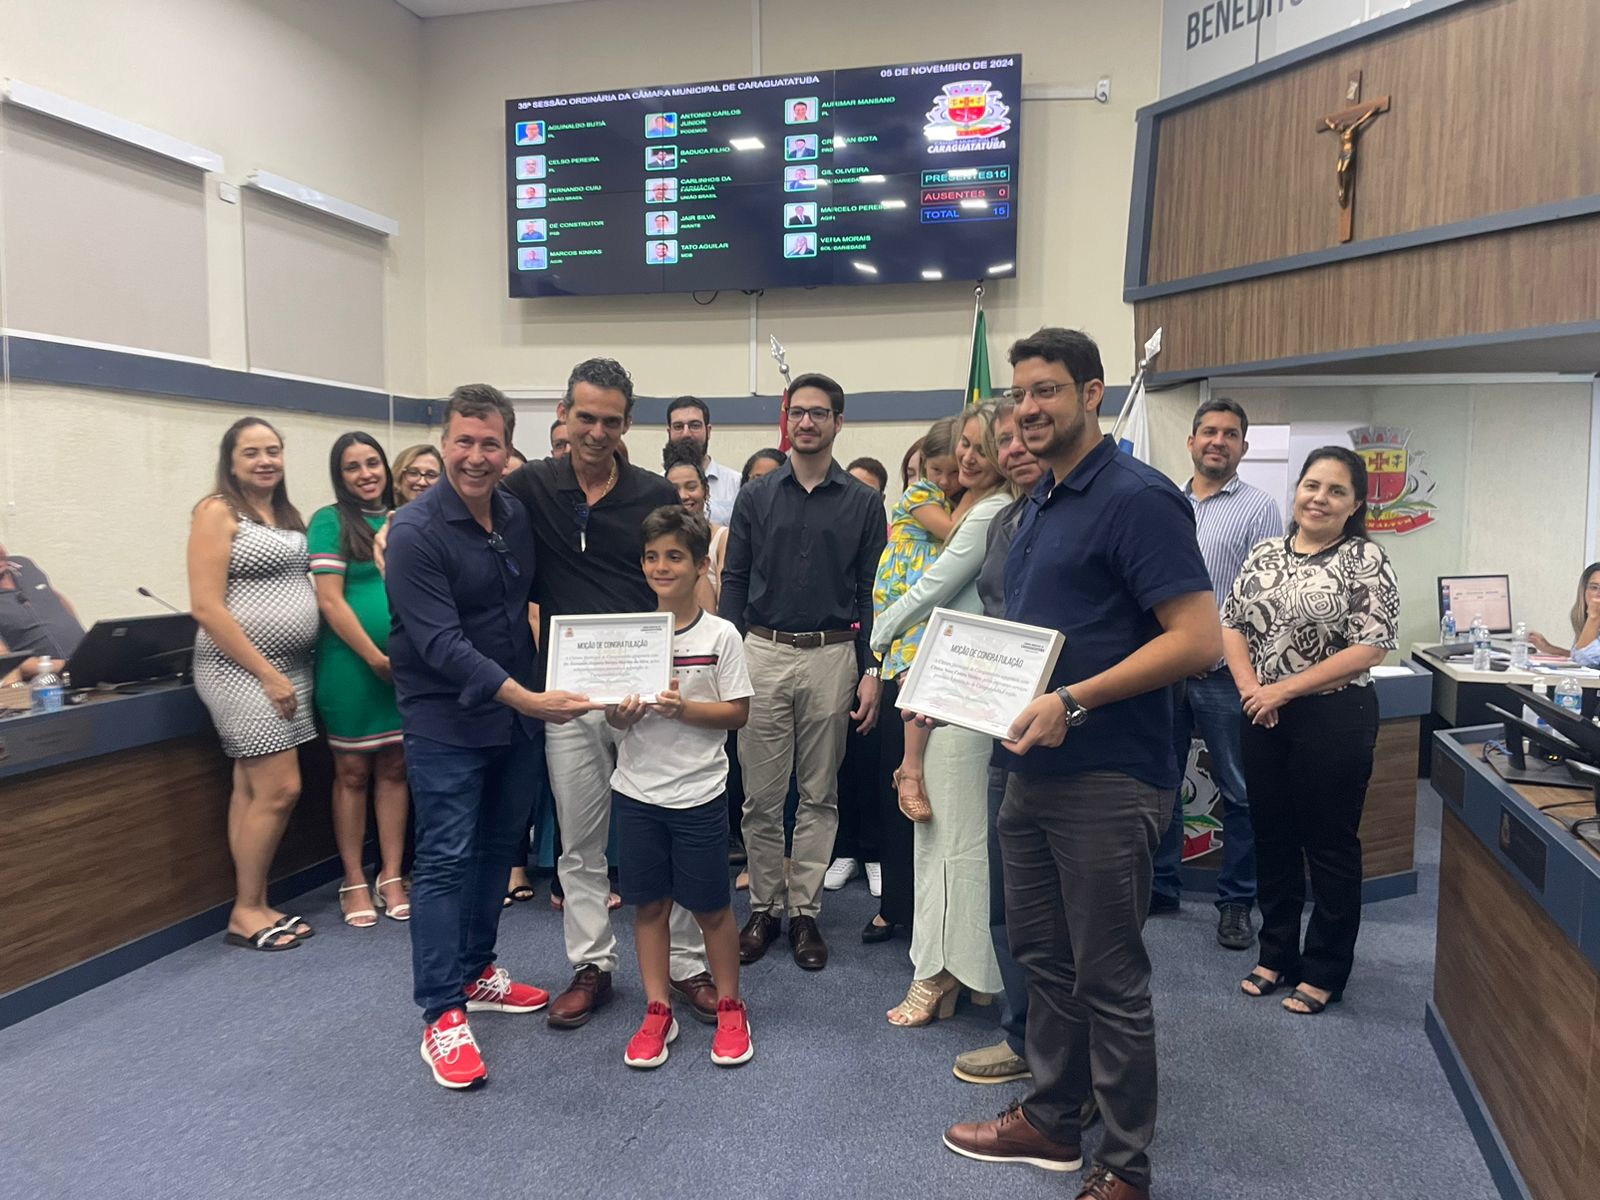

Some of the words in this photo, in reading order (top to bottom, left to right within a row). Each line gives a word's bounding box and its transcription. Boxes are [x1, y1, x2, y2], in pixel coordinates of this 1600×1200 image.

[1187, 0, 1302, 50] BENED
[895, 67, 909, 76] DE
[911, 63, 970, 75] NOVEMBRO
[973, 61, 987, 70] DE
[990, 58, 1013, 68] 2024
[533, 98, 567, 109] SESSÃO
[569, 93, 616, 105] ORDINÁRIA
[618, 93, 631, 101] DA
[632, 89, 670, 99] CÂMARA
[672, 85, 721, 96] MUNICIPAL
[738, 75, 820, 90] CARAGUATATUBA
[712, 109, 741, 117] CARLOS
[927, 140, 1006, 153] CARAGUATATUBA
[924, 190, 985, 200] AUSENTES
[924, 210, 959, 219] TOTAL
[577, 641, 595, 649] MOÇÃO
[604, 640, 648, 649] CONGRATULAÇÃO
[951, 644, 968, 656] MOÇÃO
[969, 648, 977, 657] DE
[977, 650, 1024, 668] CONGRATULAÇÃO
